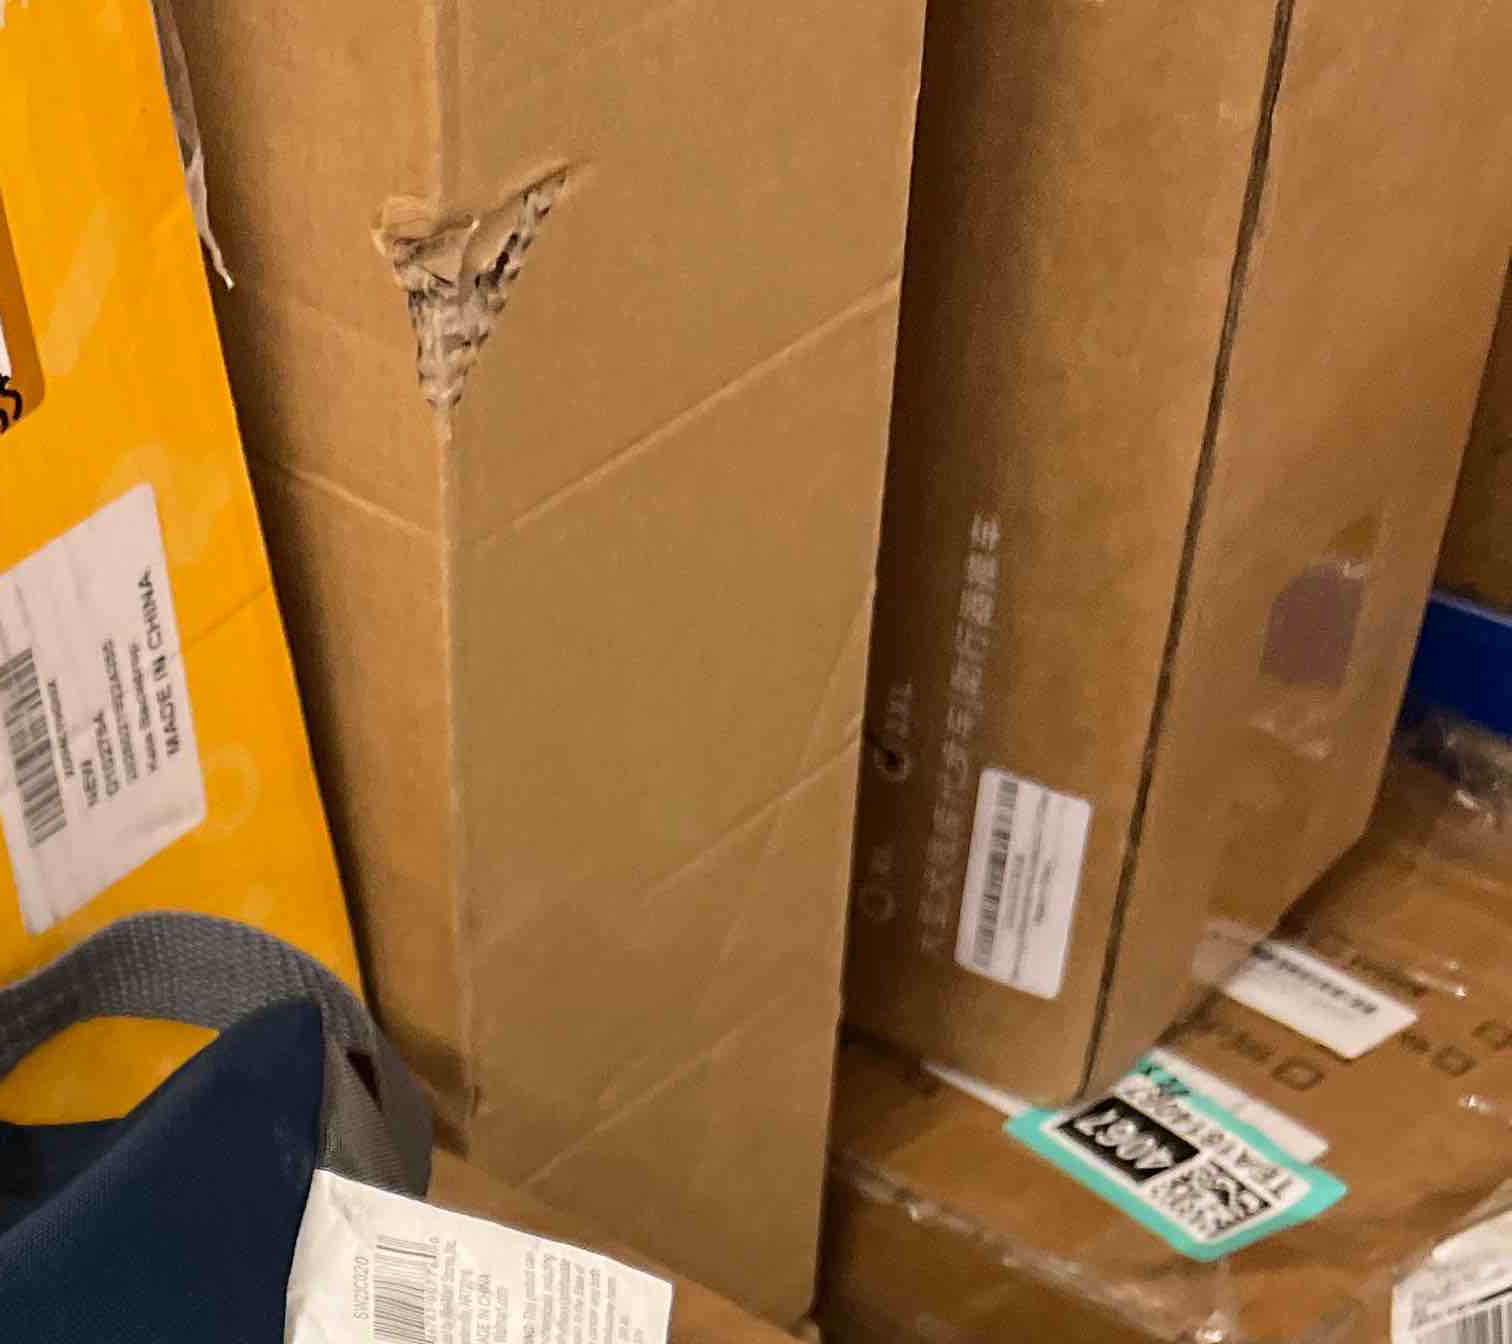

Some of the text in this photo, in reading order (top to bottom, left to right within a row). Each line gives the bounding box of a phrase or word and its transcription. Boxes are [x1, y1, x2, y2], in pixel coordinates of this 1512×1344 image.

[135, 567, 182, 757] MADE IN CHINA
[1071, 1108, 1178, 1174] 4067
